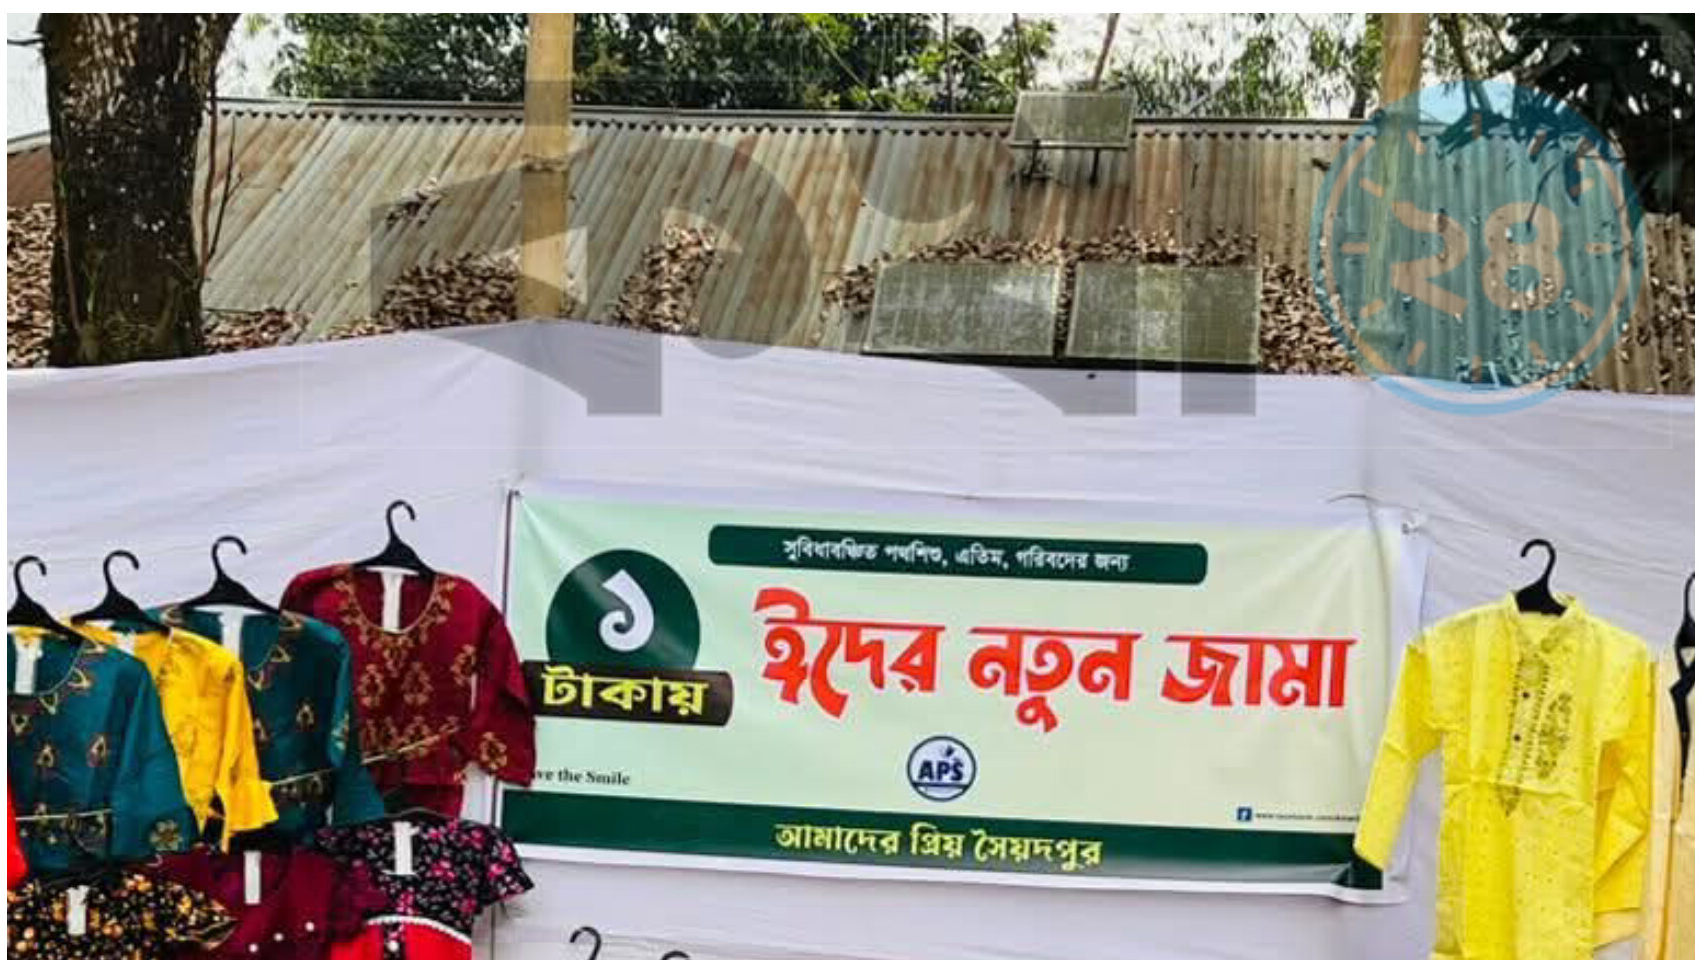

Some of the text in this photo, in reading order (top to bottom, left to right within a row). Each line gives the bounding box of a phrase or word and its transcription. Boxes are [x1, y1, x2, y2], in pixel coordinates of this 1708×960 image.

[783, 535, 878, 562] সুবিধাবঞ্চিত
[954, 543, 1009, 570] এতিম,
[1015, 546, 1088, 570] গরিবদের
[1094, 551, 1129, 571] জন্য
[598, 569, 655, 652] ১
[754, 587, 1357, 732] ঈদের নতুন জামা
[542, 664, 710, 716] টাকায়
[558, 767, 580, 784] the
[585, 770, 631, 786] Smile
[917, 758, 965, 782] APS
[774, 822, 1103, 871] আমাদের প্রিয় সৈয়দপুর
